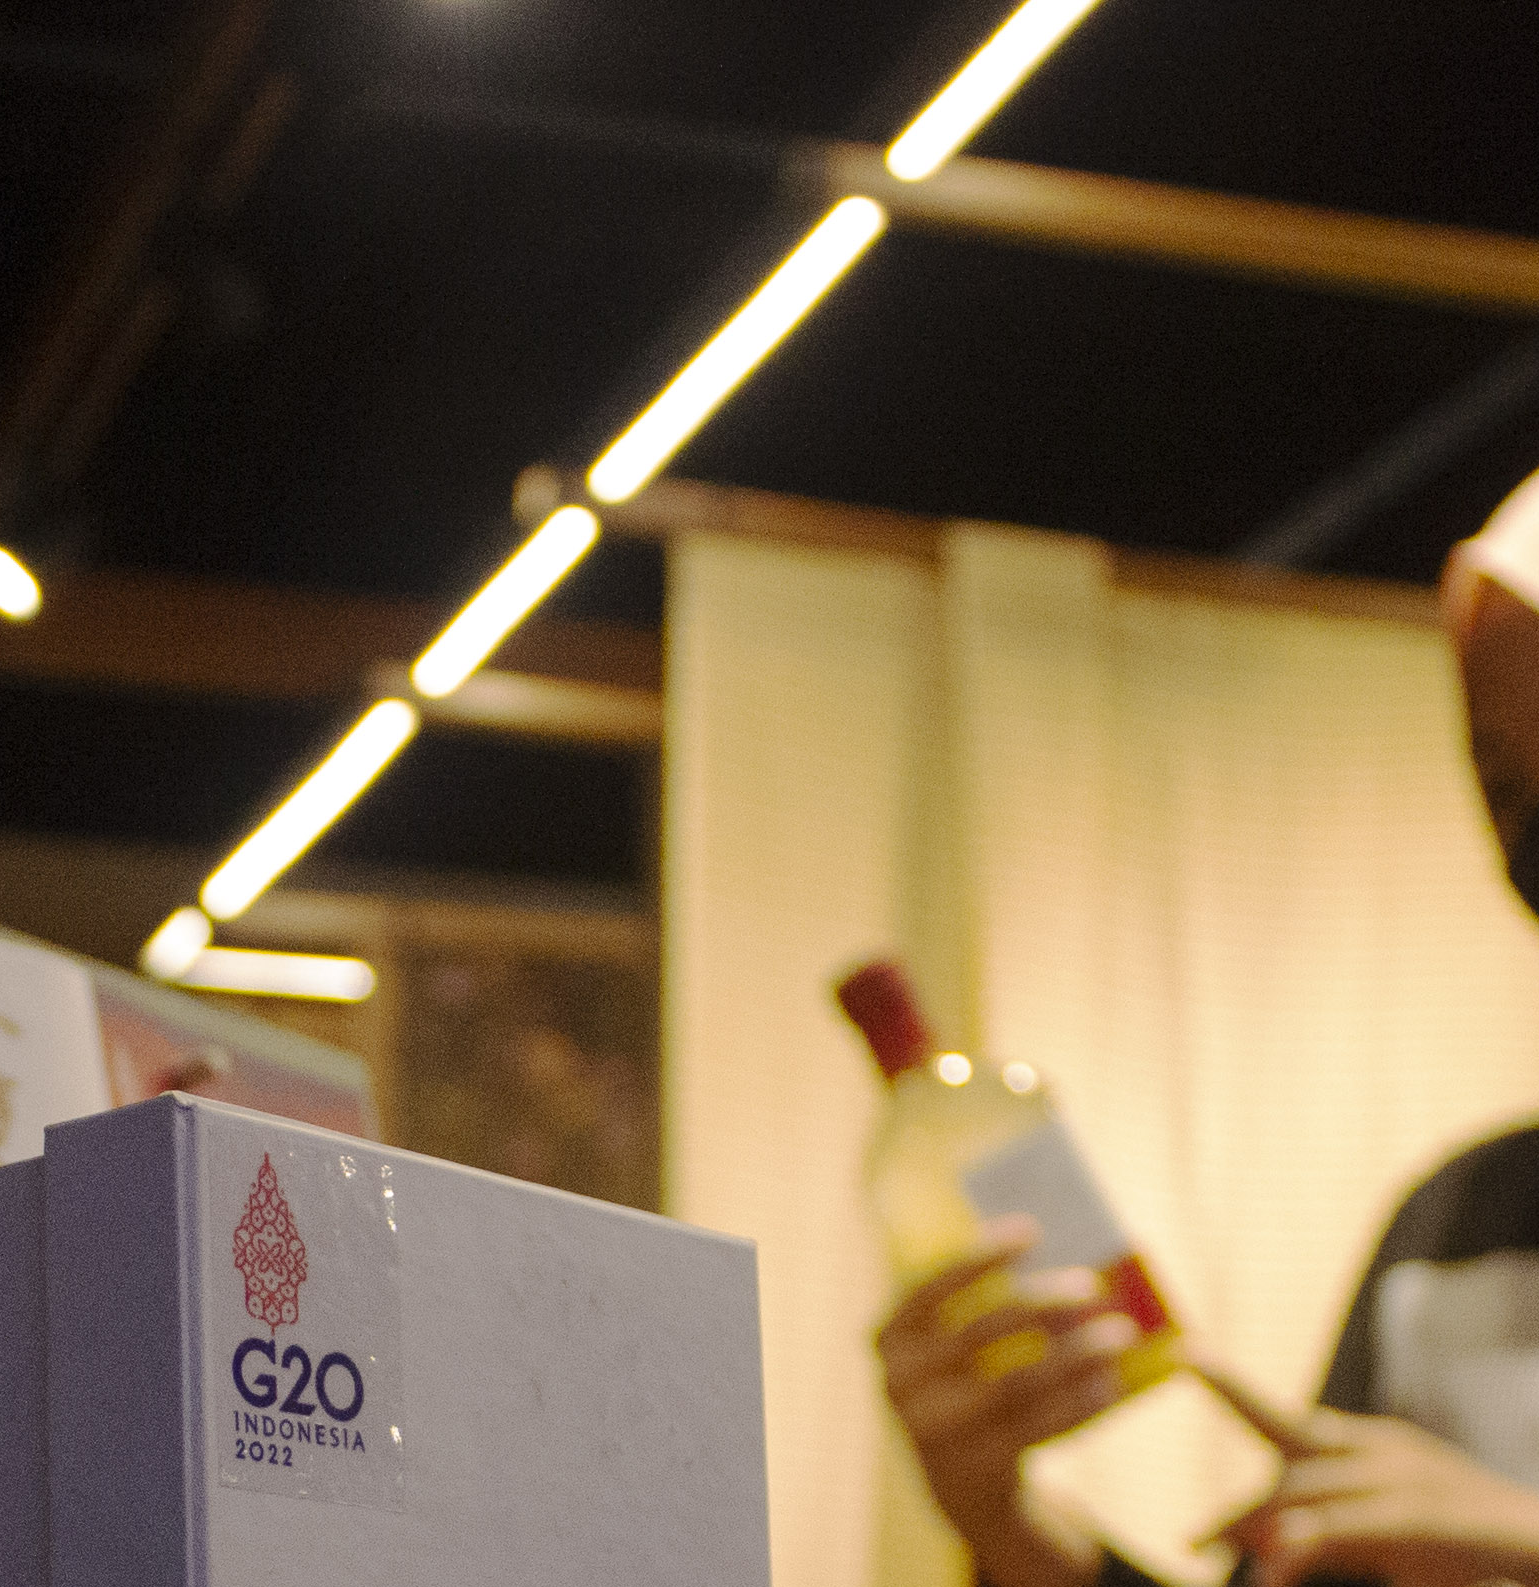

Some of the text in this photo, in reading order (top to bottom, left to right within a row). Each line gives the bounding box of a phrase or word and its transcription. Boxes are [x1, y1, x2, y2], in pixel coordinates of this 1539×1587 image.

[232, 1337, 364, 1423] G20
[233, 1410, 366, 1453] INDONESIA
[235, 1438, 294, 1468] 2022
